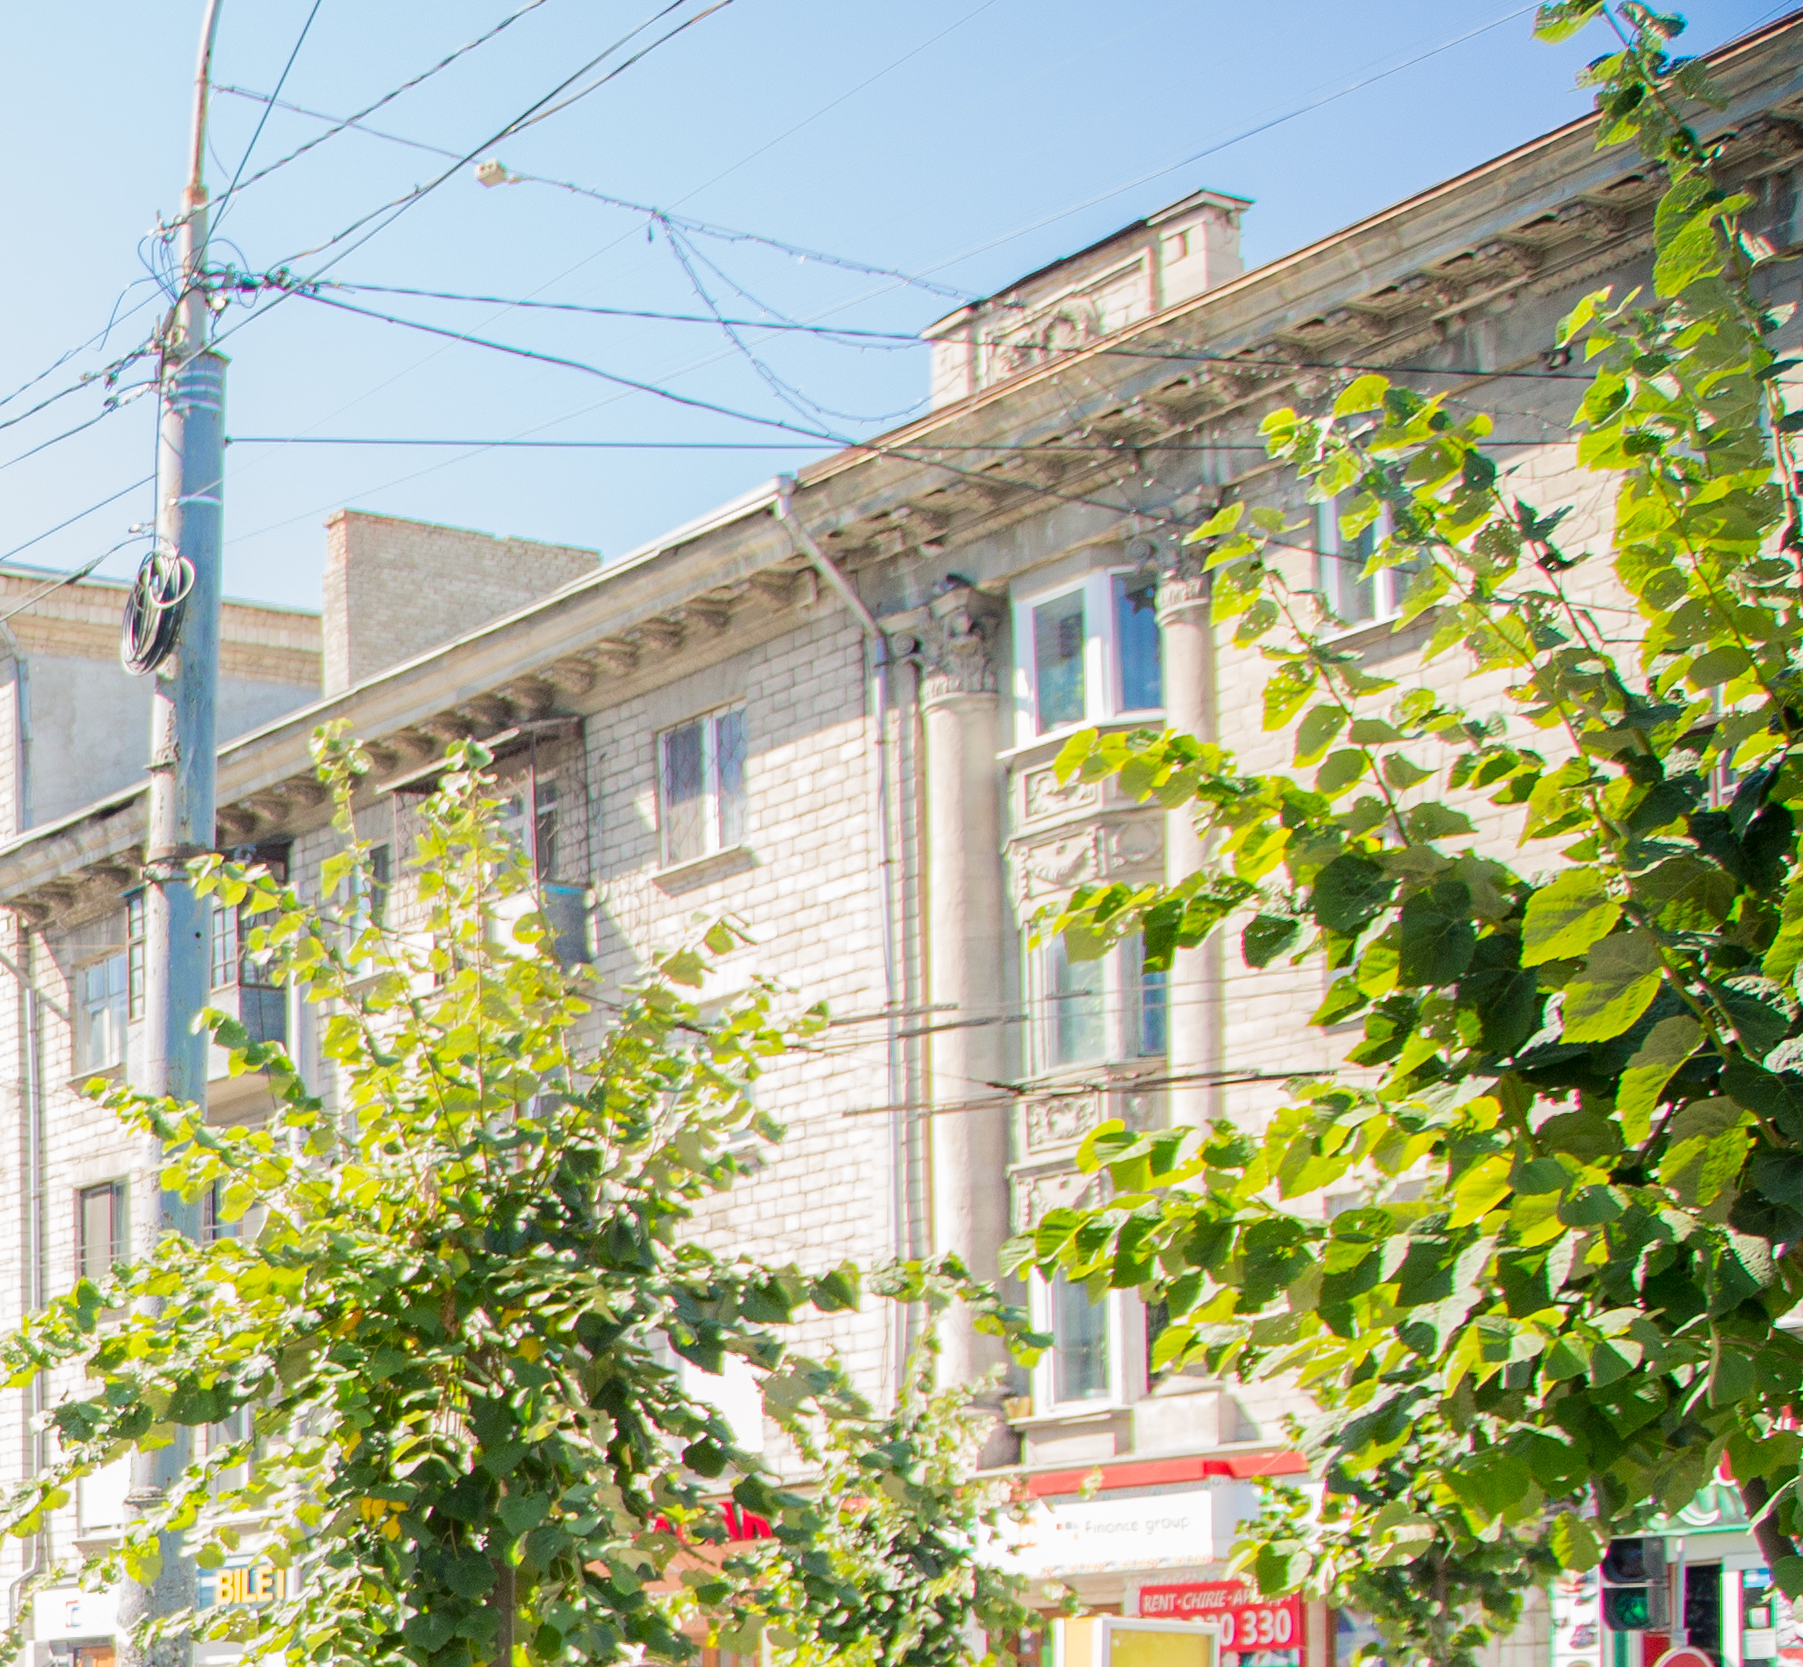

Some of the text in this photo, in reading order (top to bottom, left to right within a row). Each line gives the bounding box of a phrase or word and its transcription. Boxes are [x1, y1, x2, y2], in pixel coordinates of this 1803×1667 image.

[1085, 1515, 1190, 1536] finance group
[1144, 1592, 1177, 1613] RENT
[1181, 1588, 1227, 1610] CHIRIE
[1241, 1607, 1293, 1646] 330
